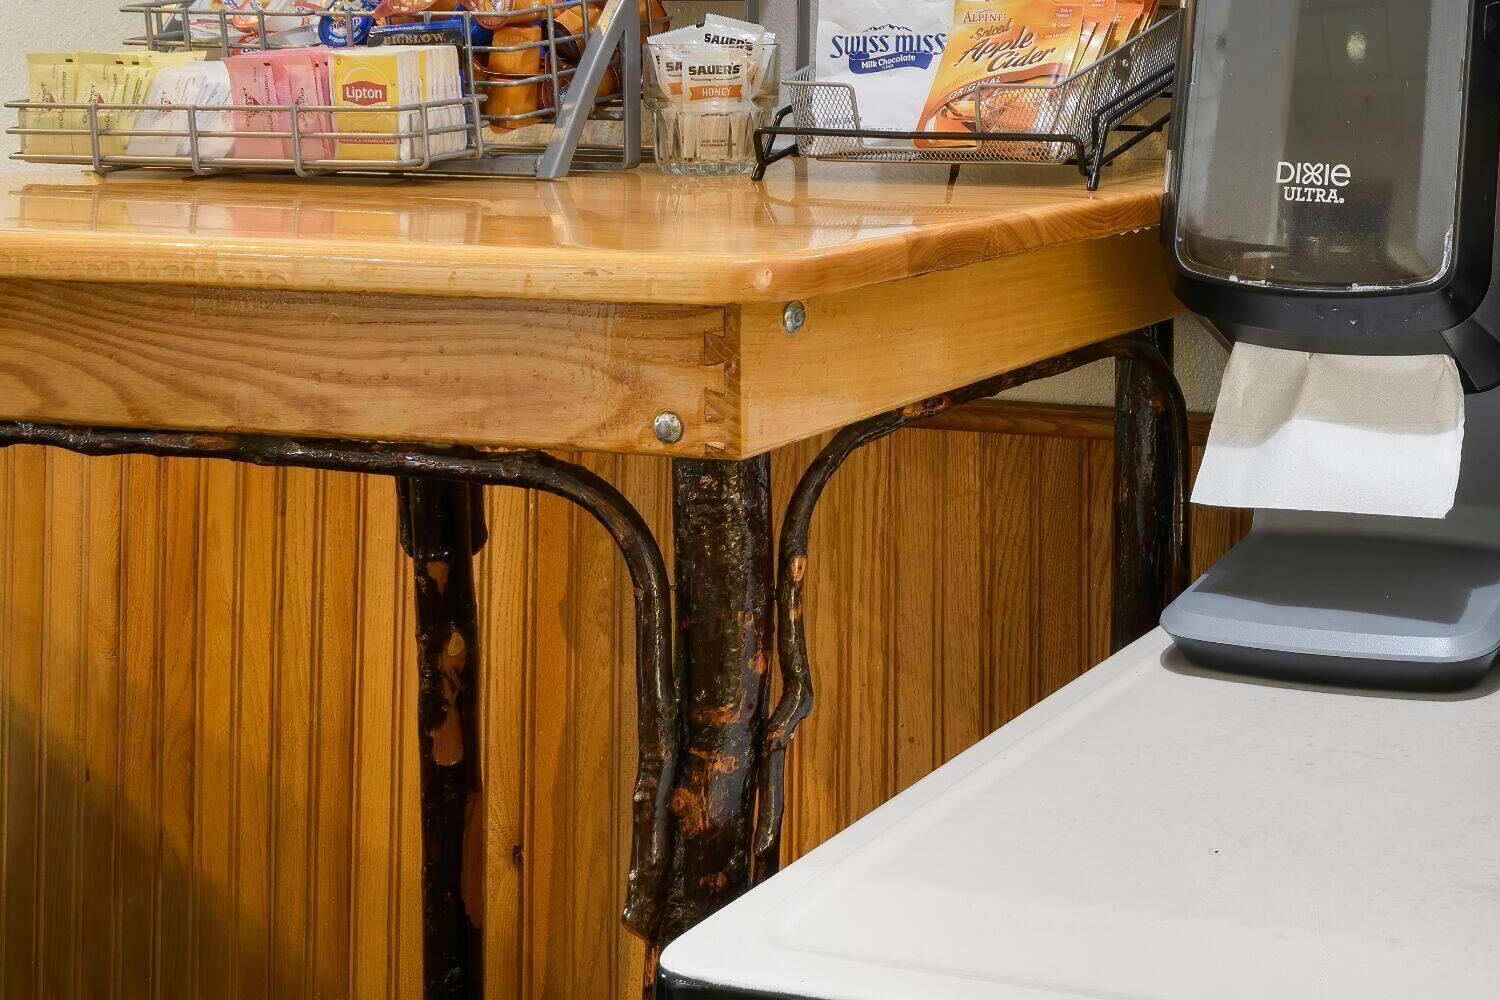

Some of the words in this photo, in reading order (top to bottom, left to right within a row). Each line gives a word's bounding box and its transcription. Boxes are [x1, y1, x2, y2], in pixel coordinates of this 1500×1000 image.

[963, 10, 1005, 23] ALPINE
[970, 18, 1012, 40] Spiced
[954, 25, 1034, 66] Apple
[861, 60, 877, 69] Milk
[878, 54, 916, 66] Chocolate
[987, 48, 1056, 72] Cider
[688, 62, 742, 76] SAUER'S
[345, 86, 383, 101] Lipton
[702, 86, 732, 97] HONEY
[949, 76, 1001, 100] ORIGINAL
